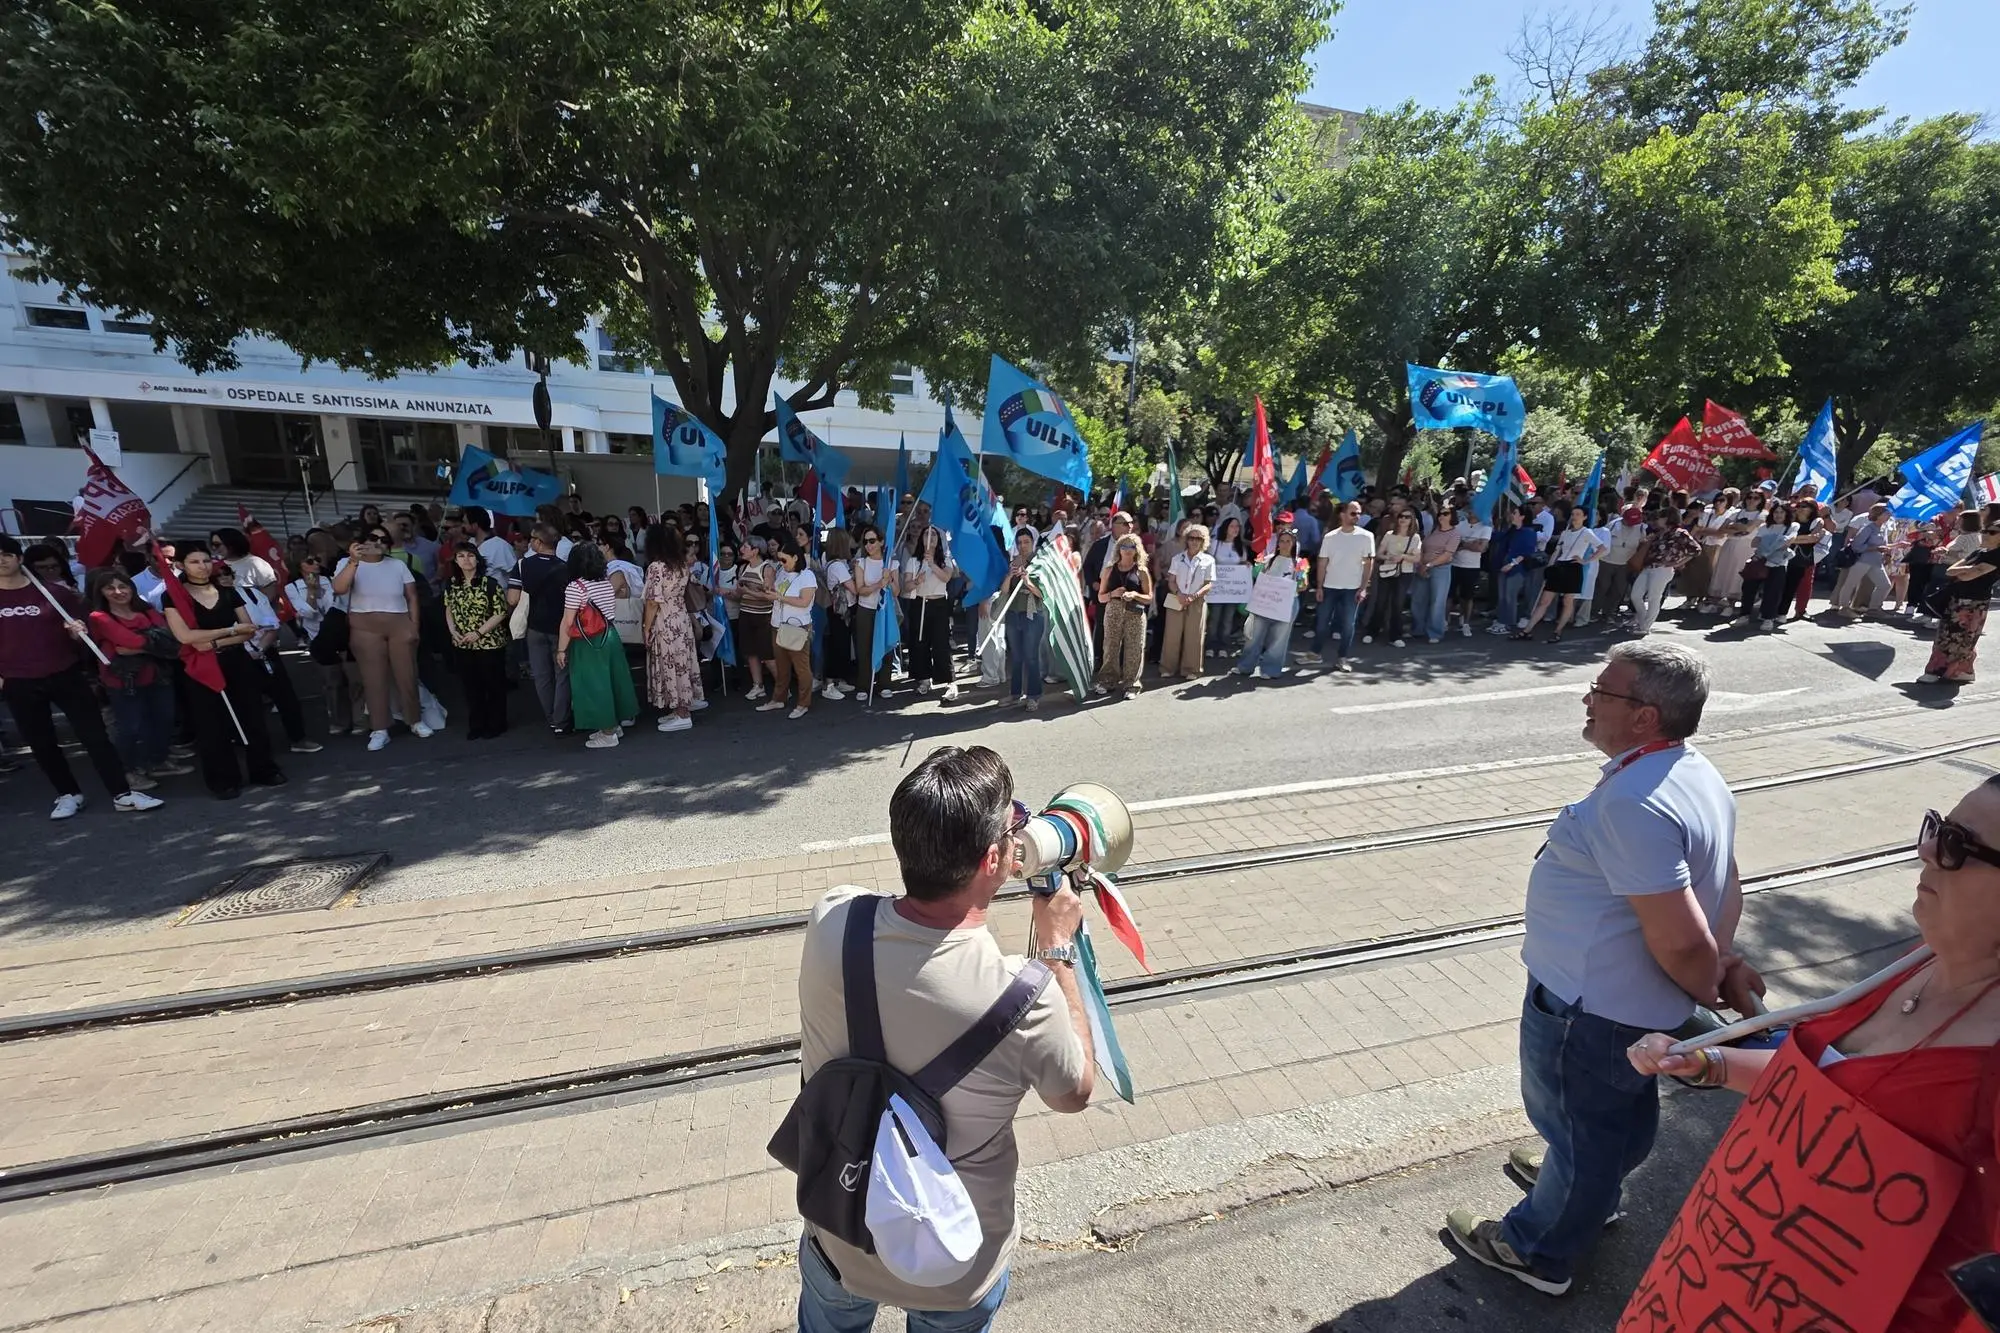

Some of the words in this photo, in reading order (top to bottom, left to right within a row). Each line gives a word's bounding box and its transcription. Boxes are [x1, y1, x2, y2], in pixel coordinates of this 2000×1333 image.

[227, 387, 305, 404] OSPEDALE
[312, 393, 400, 410] SANTISSIMA
[406, 399, 492, 415] ANNUNZIATA
